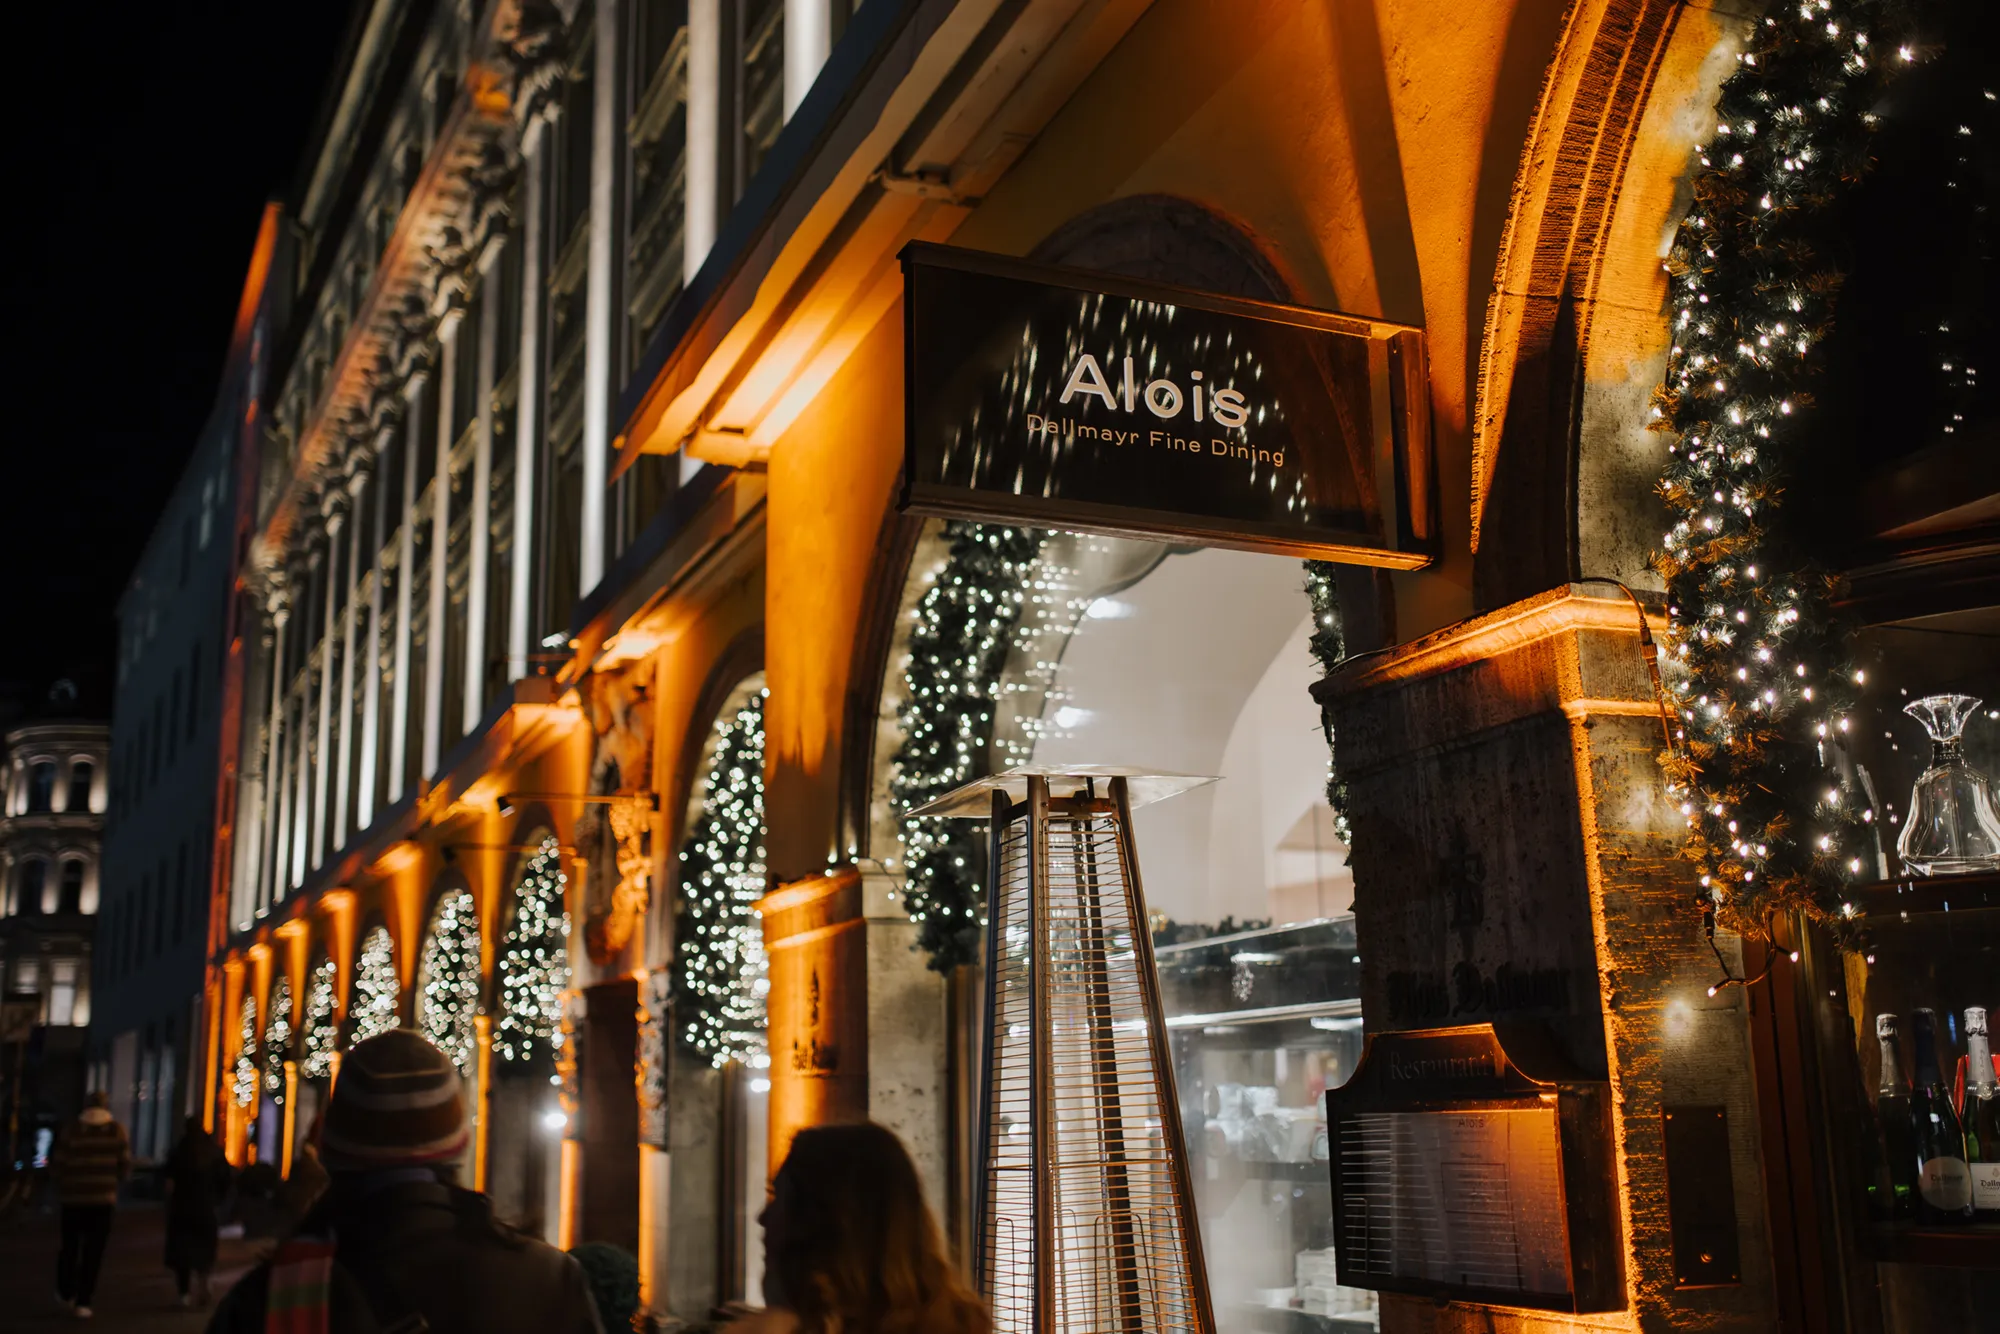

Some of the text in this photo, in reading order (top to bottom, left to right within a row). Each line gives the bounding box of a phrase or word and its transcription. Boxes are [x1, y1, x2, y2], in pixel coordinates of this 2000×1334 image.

[1059, 353, 1249, 428] Alois
[1026, 413, 1285, 468] Dallmayr Fine Dining
